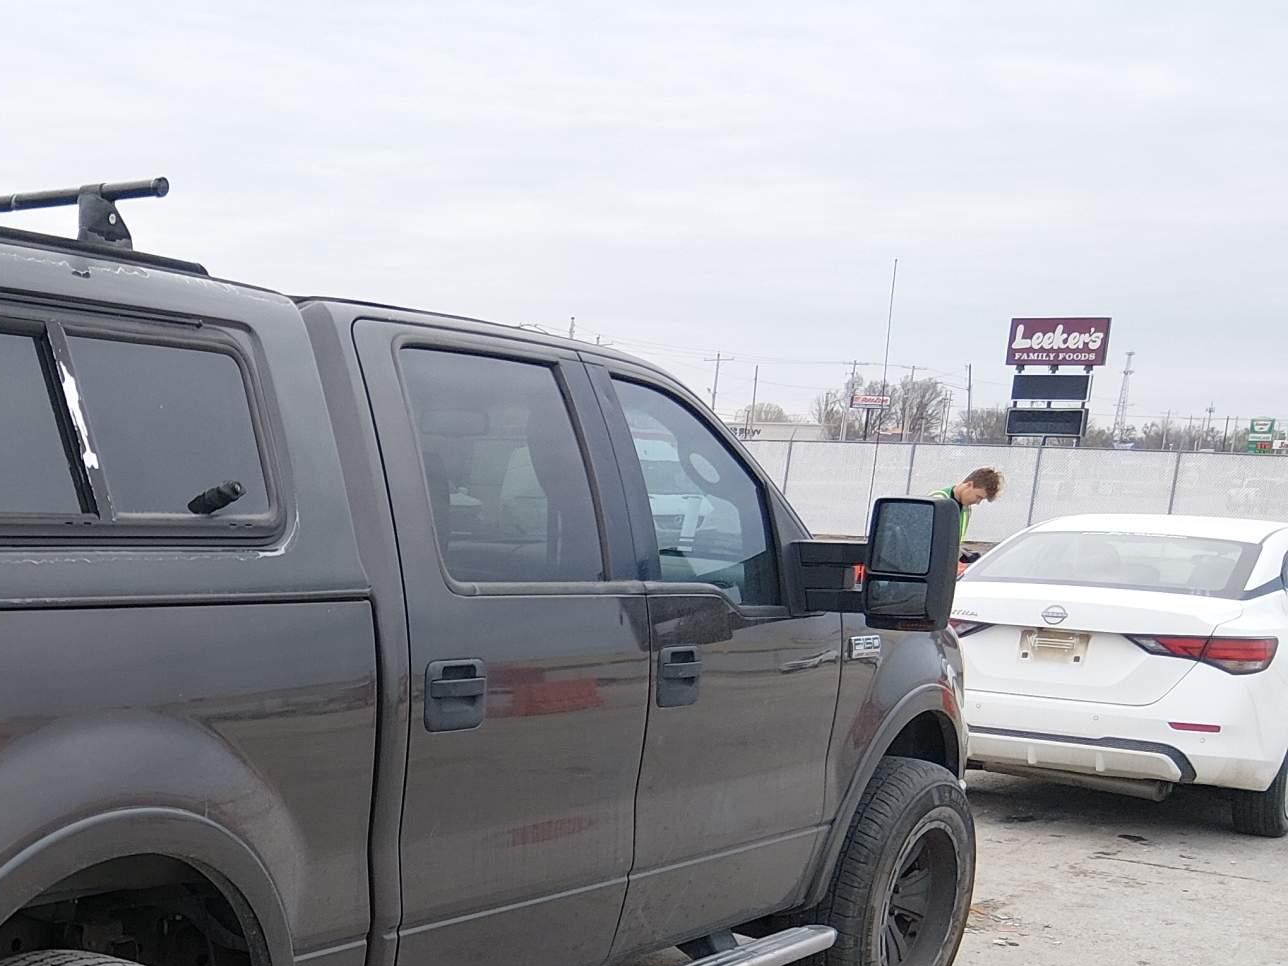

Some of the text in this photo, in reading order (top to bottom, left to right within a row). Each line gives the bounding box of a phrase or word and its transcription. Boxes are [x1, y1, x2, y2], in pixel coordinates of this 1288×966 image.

[1012, 324, 1104, 350] Leeker's
[1014, 352, 1096, 361] FAMILY FOODS
